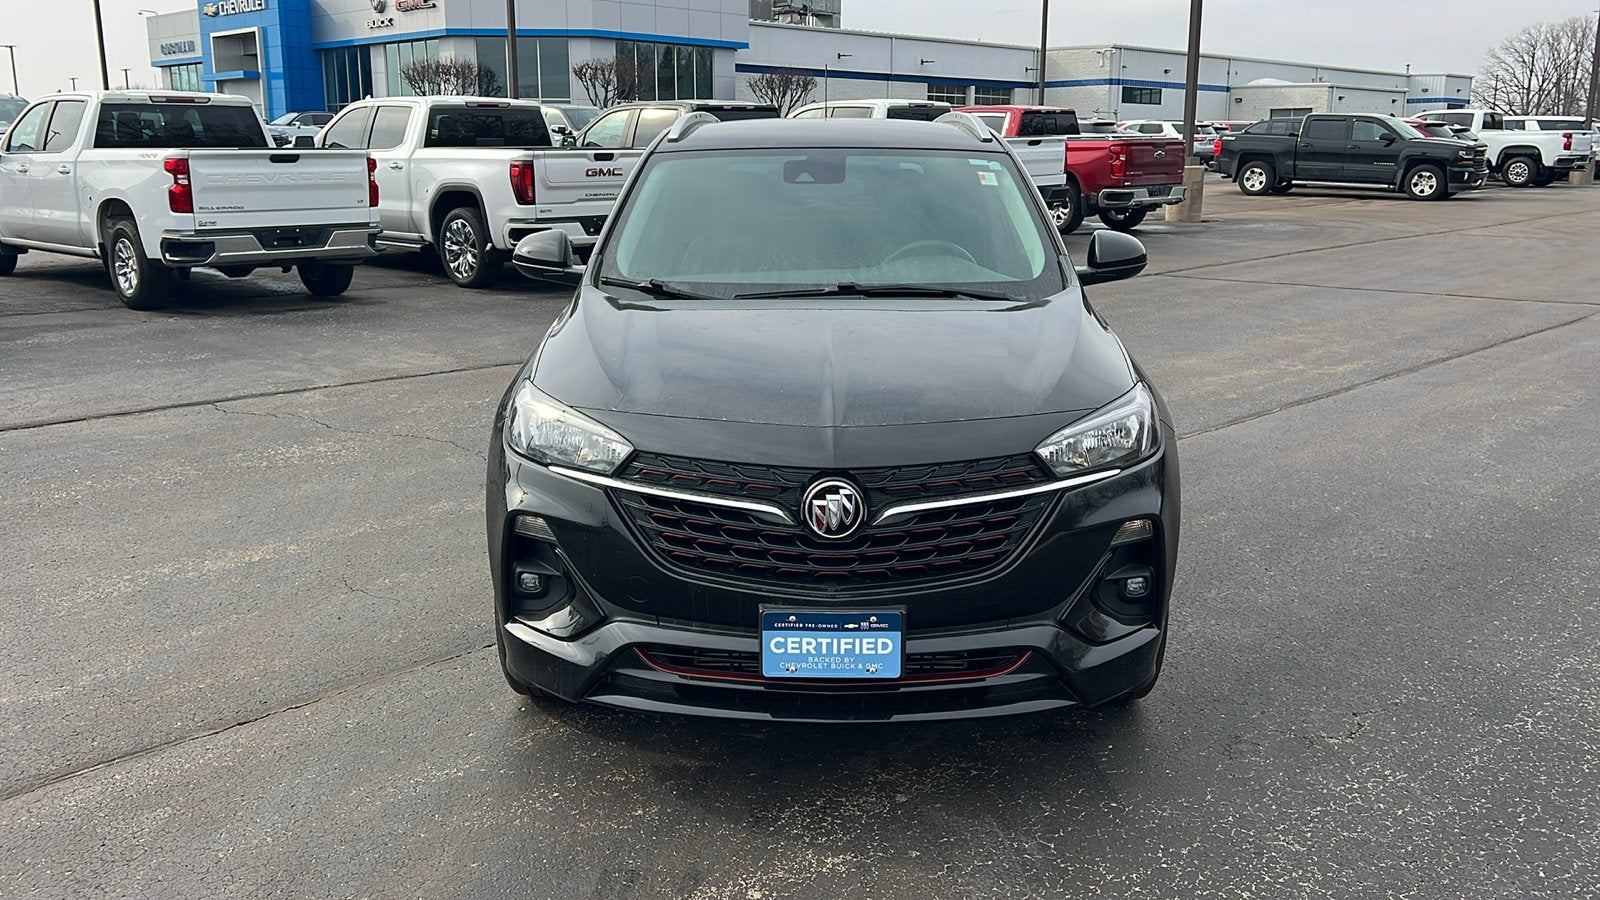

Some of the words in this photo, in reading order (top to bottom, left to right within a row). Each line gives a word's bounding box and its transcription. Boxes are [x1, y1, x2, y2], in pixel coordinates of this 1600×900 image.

[218, 0, 266, 16] CHEVROLET
[395, 0, 437, 12] GMC
[366, 17, 394, 29] BUICK
[585, 167, 623, 177] GMC
[206, 172, 359, 185] CHEVROLET
[769, 636, 894, 655] CERTIFIED
[779, 662, 828, 670] CHEVROLET
[808, 656, 842, 664] BACKED
